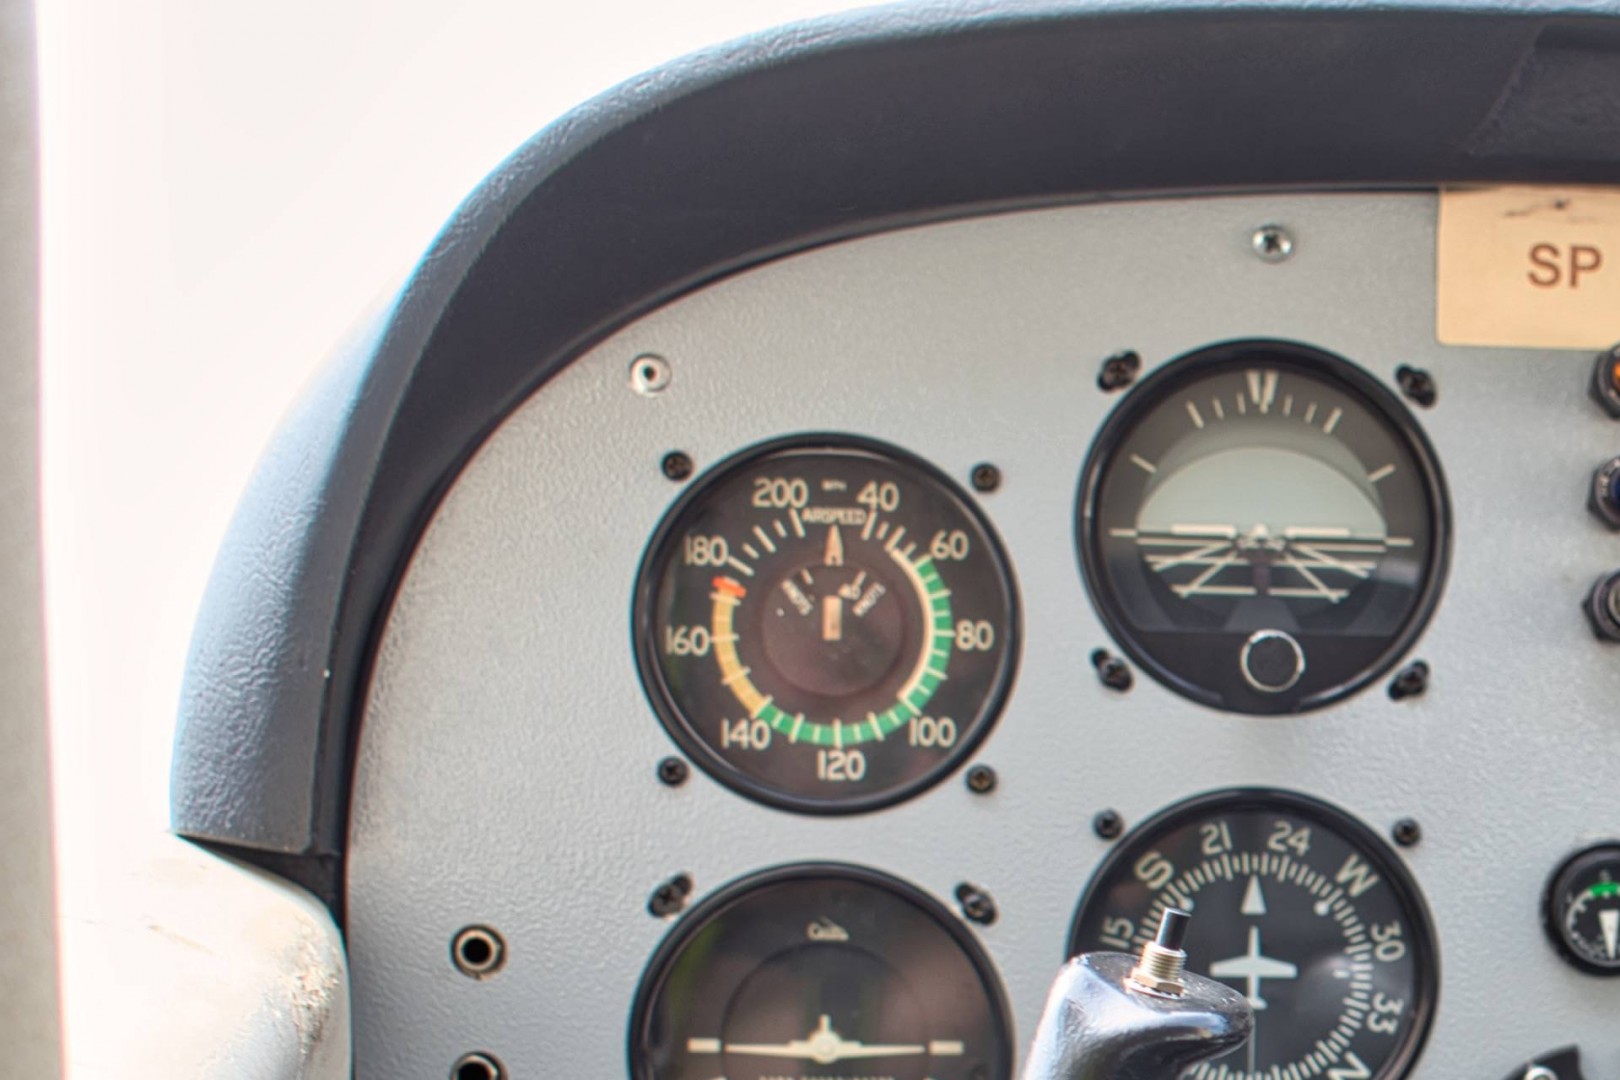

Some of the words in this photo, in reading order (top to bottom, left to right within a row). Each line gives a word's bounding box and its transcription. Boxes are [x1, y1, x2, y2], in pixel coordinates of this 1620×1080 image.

[1527, 243, 1602, 289] SP
[753, 478, 809, 508] 200
[857, 481, 900, 512] 40
[801, 507, 867, 525] AIRSPEED
[685, 536, 727, 566] 180
[930, 530, 969, 560] 60
[666, 627, 711, 656] 160
[956, 621, 993, 650] 80
[720, 720, 771, 750] 140
[909, 717, 957, 747] 100
[817, 750, 865, 781] 120
[1201, 821, 1233, 855] 21
[1267, 820, 1312, 855] 24
[1134, 851, 1174, 891] S
[1335, 854, 1380, 898] W
[1102, 917, 1135, 948] 15
[1371, 919, 1405, 963] 30
[1366, 992, 1404, 1036] 33
